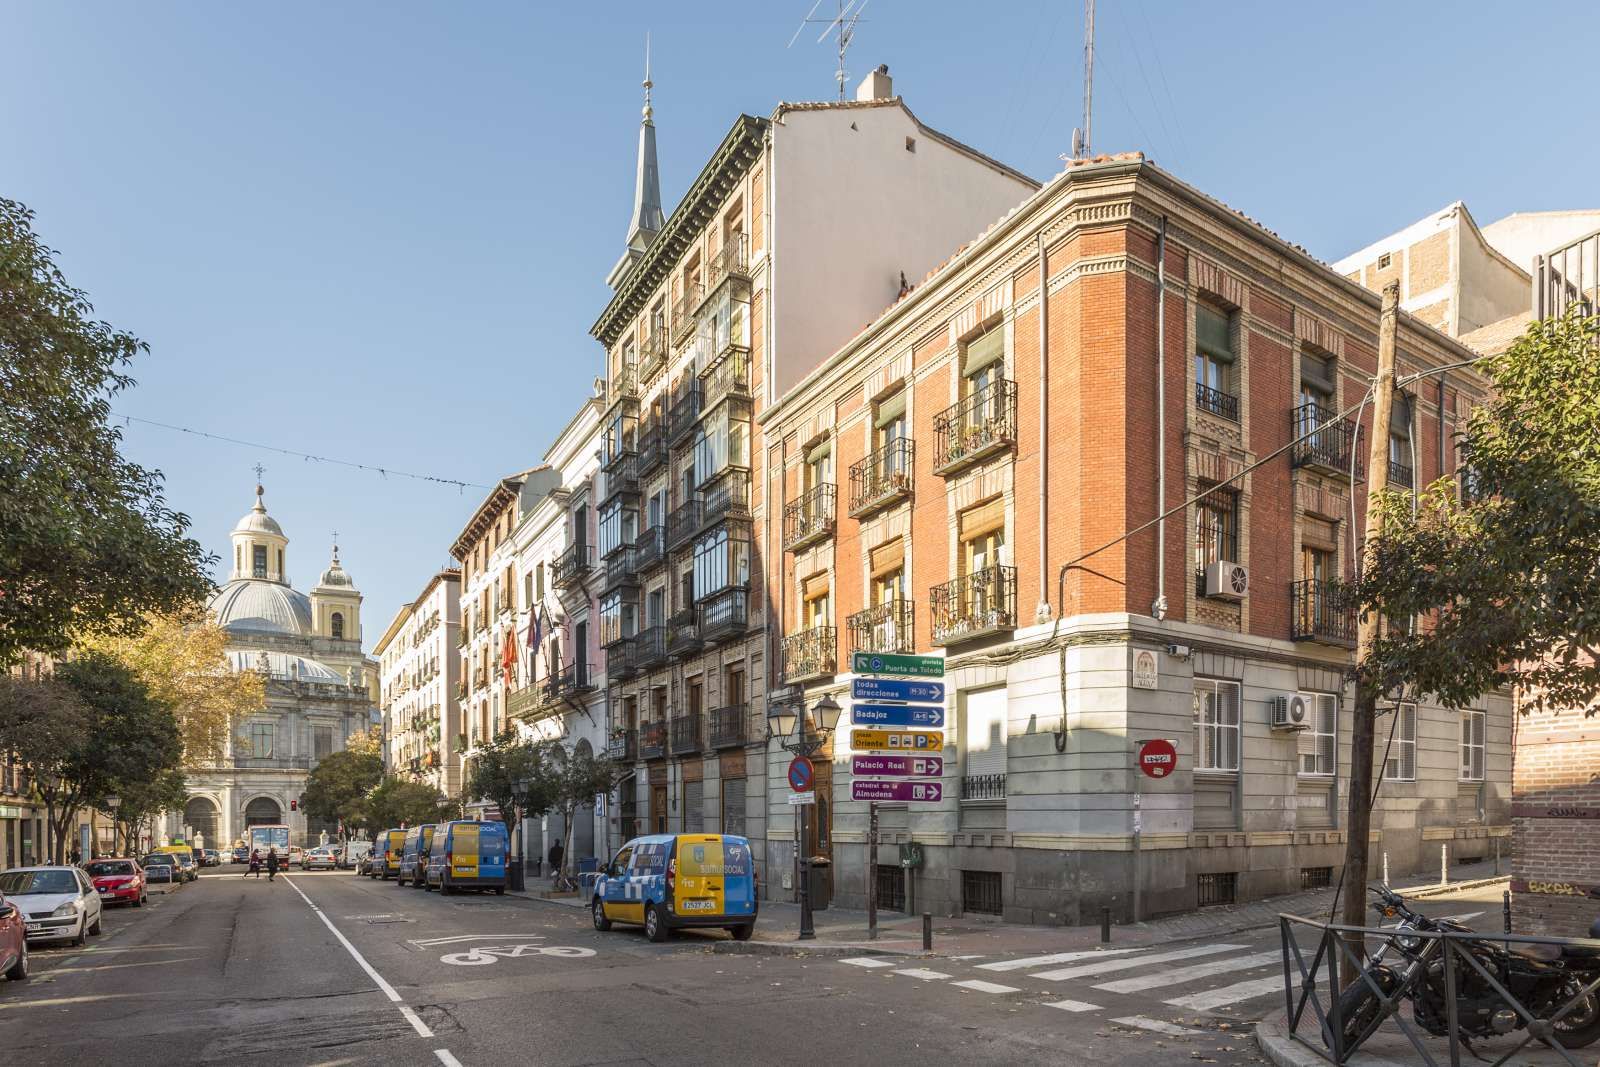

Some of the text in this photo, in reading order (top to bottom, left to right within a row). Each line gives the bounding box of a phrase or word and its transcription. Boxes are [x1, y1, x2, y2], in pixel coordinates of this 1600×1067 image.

[919, 666, 942, 674] Toledo
[856, 680, 878, 688] todas
[856, 689, 899, 698] direcciones
[856, 710, 888, 719] Badajoz
[855, 761, 905, 769] Palacio Real
[855, 790, 893, 798] Almudena
